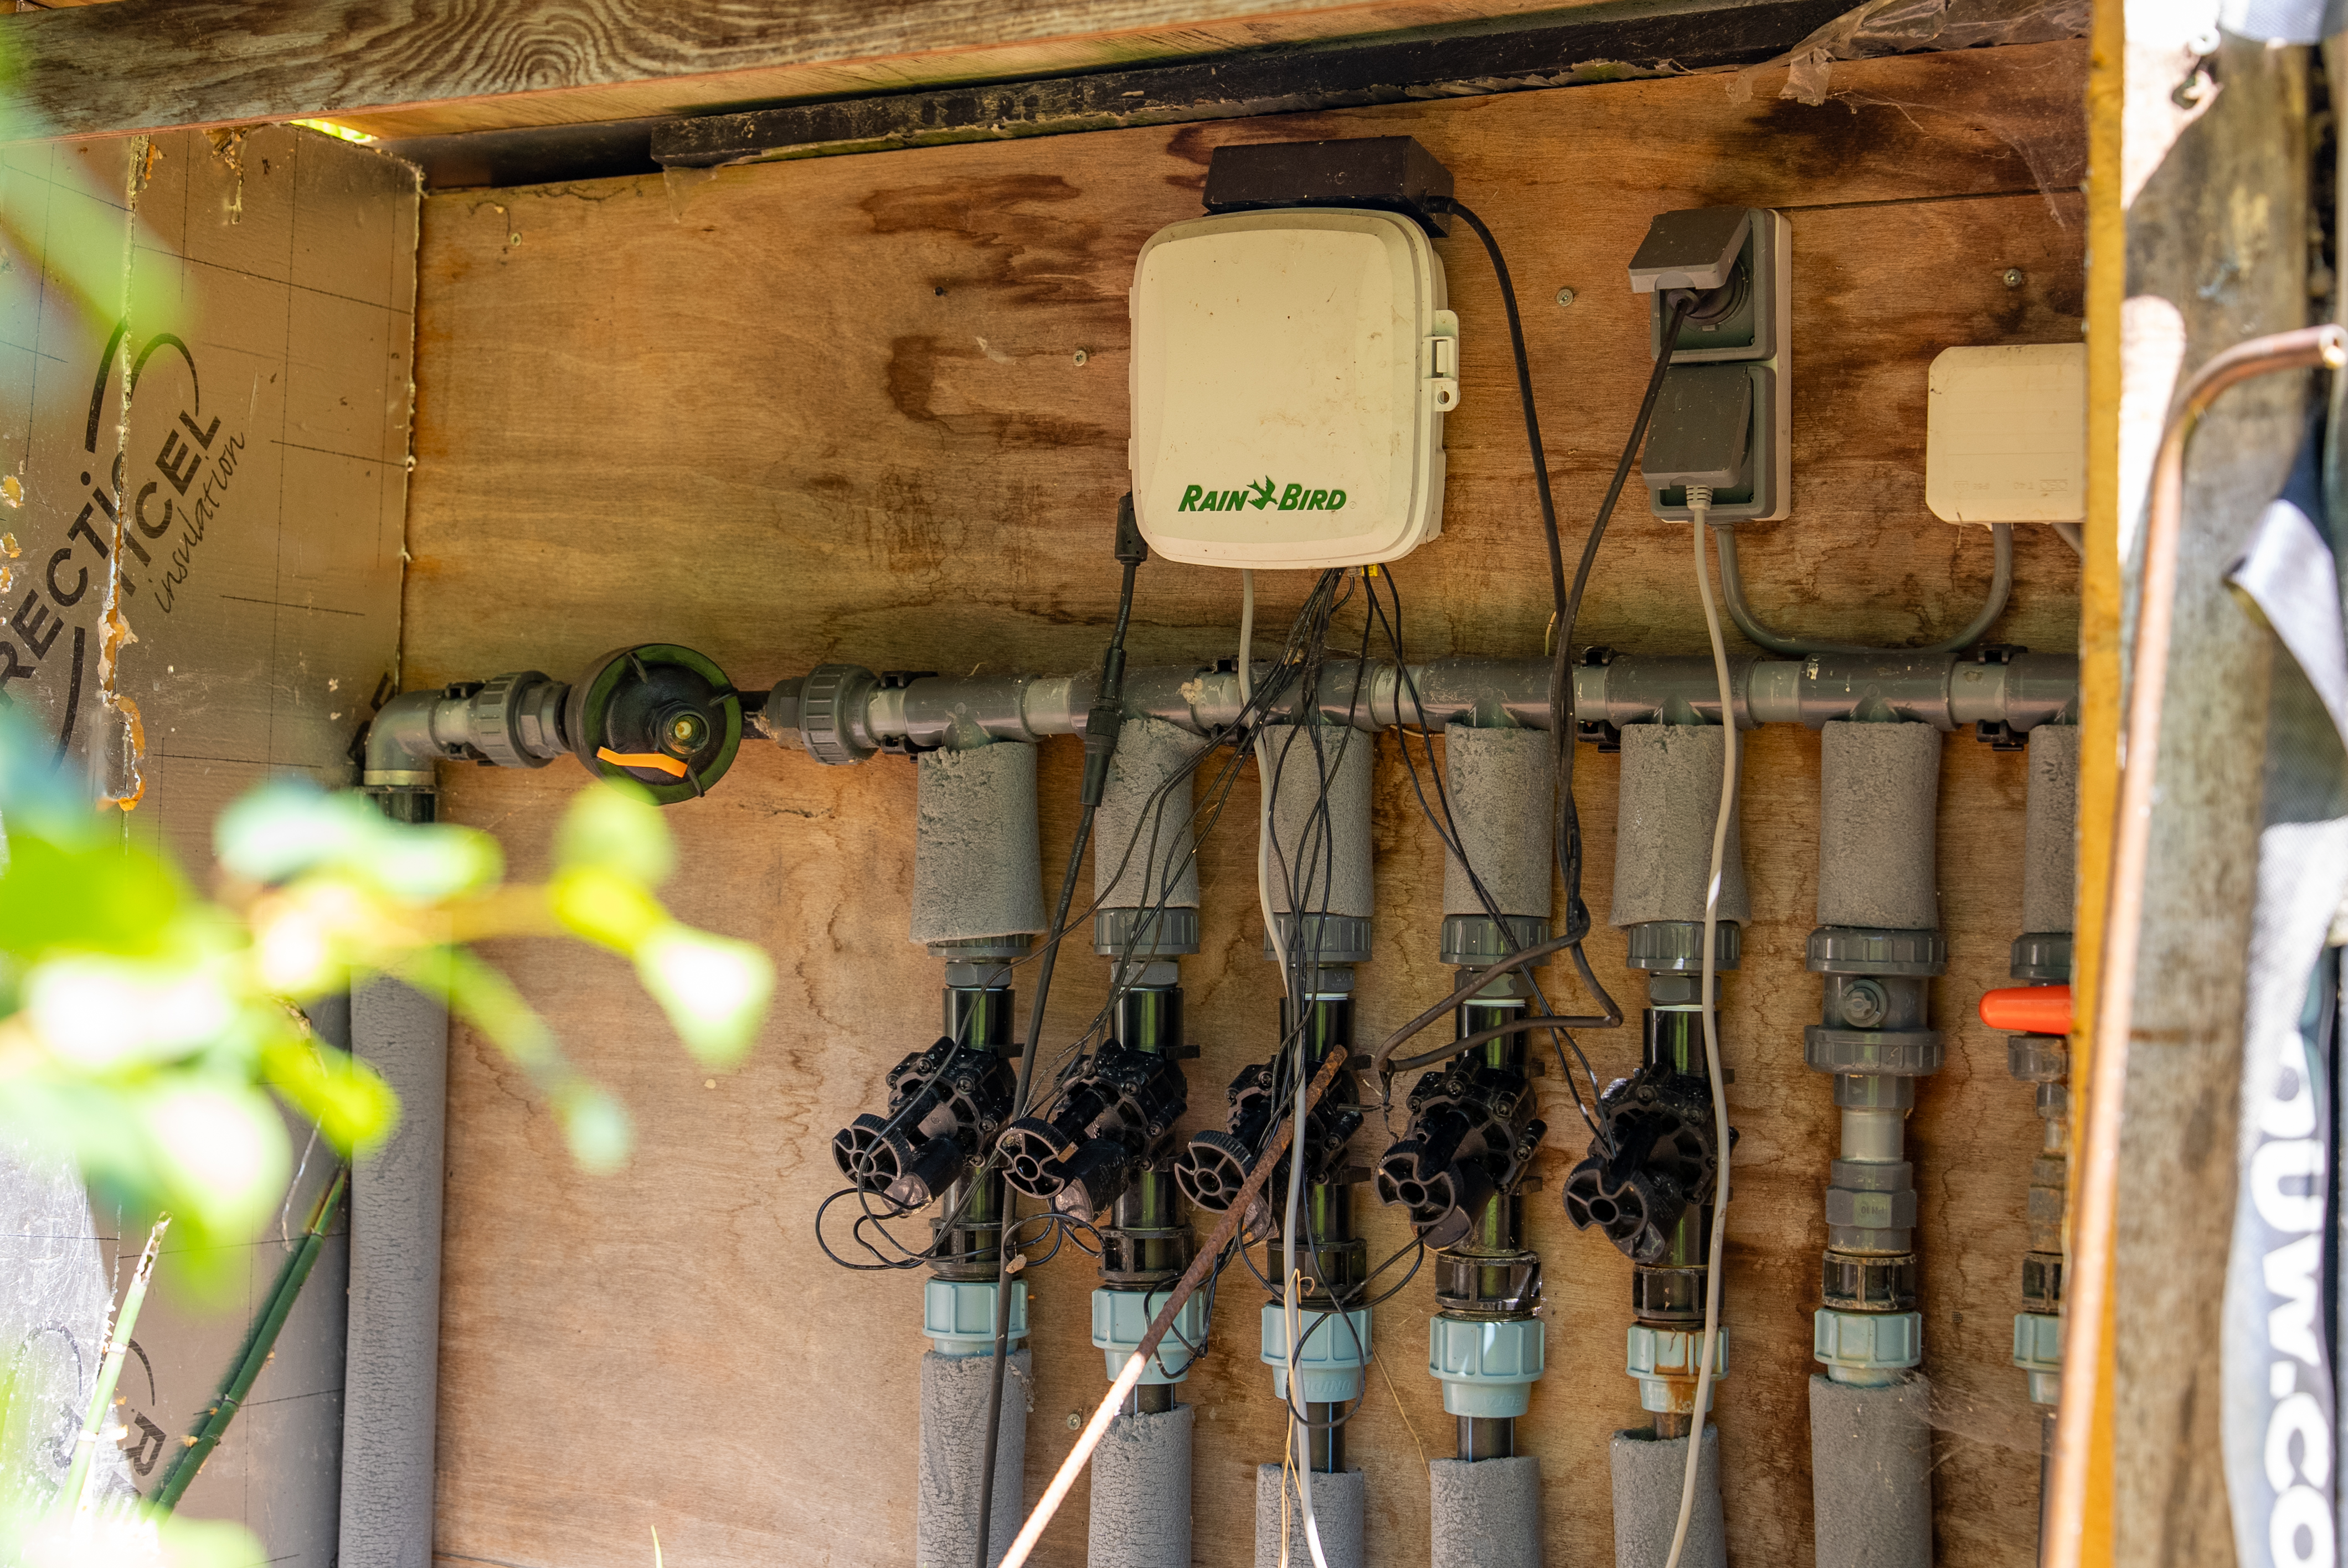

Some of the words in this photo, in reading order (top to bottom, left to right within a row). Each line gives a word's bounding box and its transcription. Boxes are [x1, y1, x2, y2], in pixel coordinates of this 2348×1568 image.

[155, 432, 246, 613] insulation
[1178, 484, 1249, 512] RAIN
[1277, 483, 1346, 510] BIRD
